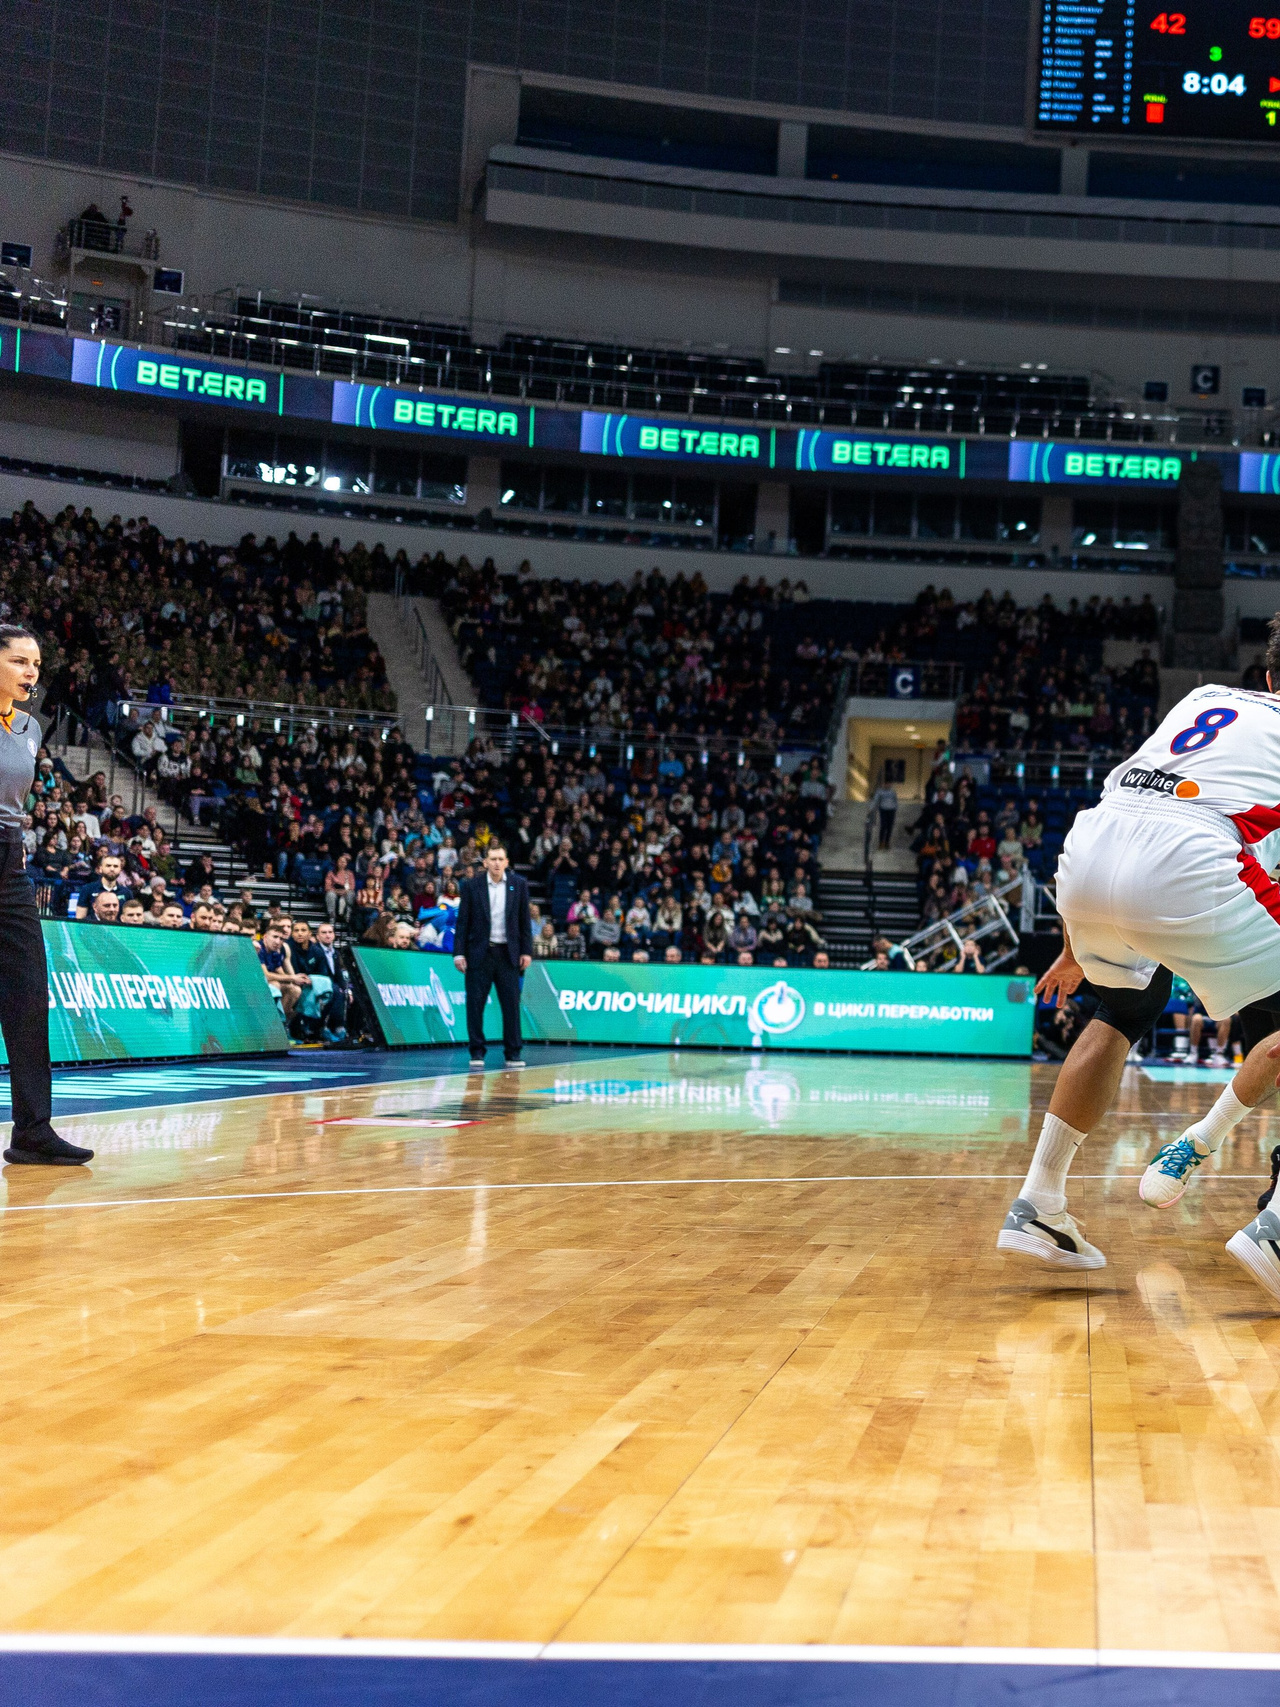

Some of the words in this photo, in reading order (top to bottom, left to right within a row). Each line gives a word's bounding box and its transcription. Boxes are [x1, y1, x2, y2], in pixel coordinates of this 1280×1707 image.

[1150, 13, 1187, 34] 42
[1209, 46, 1223, 62] 3
[1182, 70, 1247, 96] 8:04
[1265, 111, 1277, 126] 1
[1170, 707, 1239, 756] 8
[51, 971, 116, 1018] ЦИКЛ
[109, 973, 231, 1010] ПЕРЕРАБОТКИ
[558, 987, 748, 1017] ВКЛЮЧИЦИКЛ
[814, 1003, 826, 1016] В
[828, 1003, 875, 1019] ЦИКЛ
[878, 1004, 994, 1022] ПЕРЕРАБОТКИ
